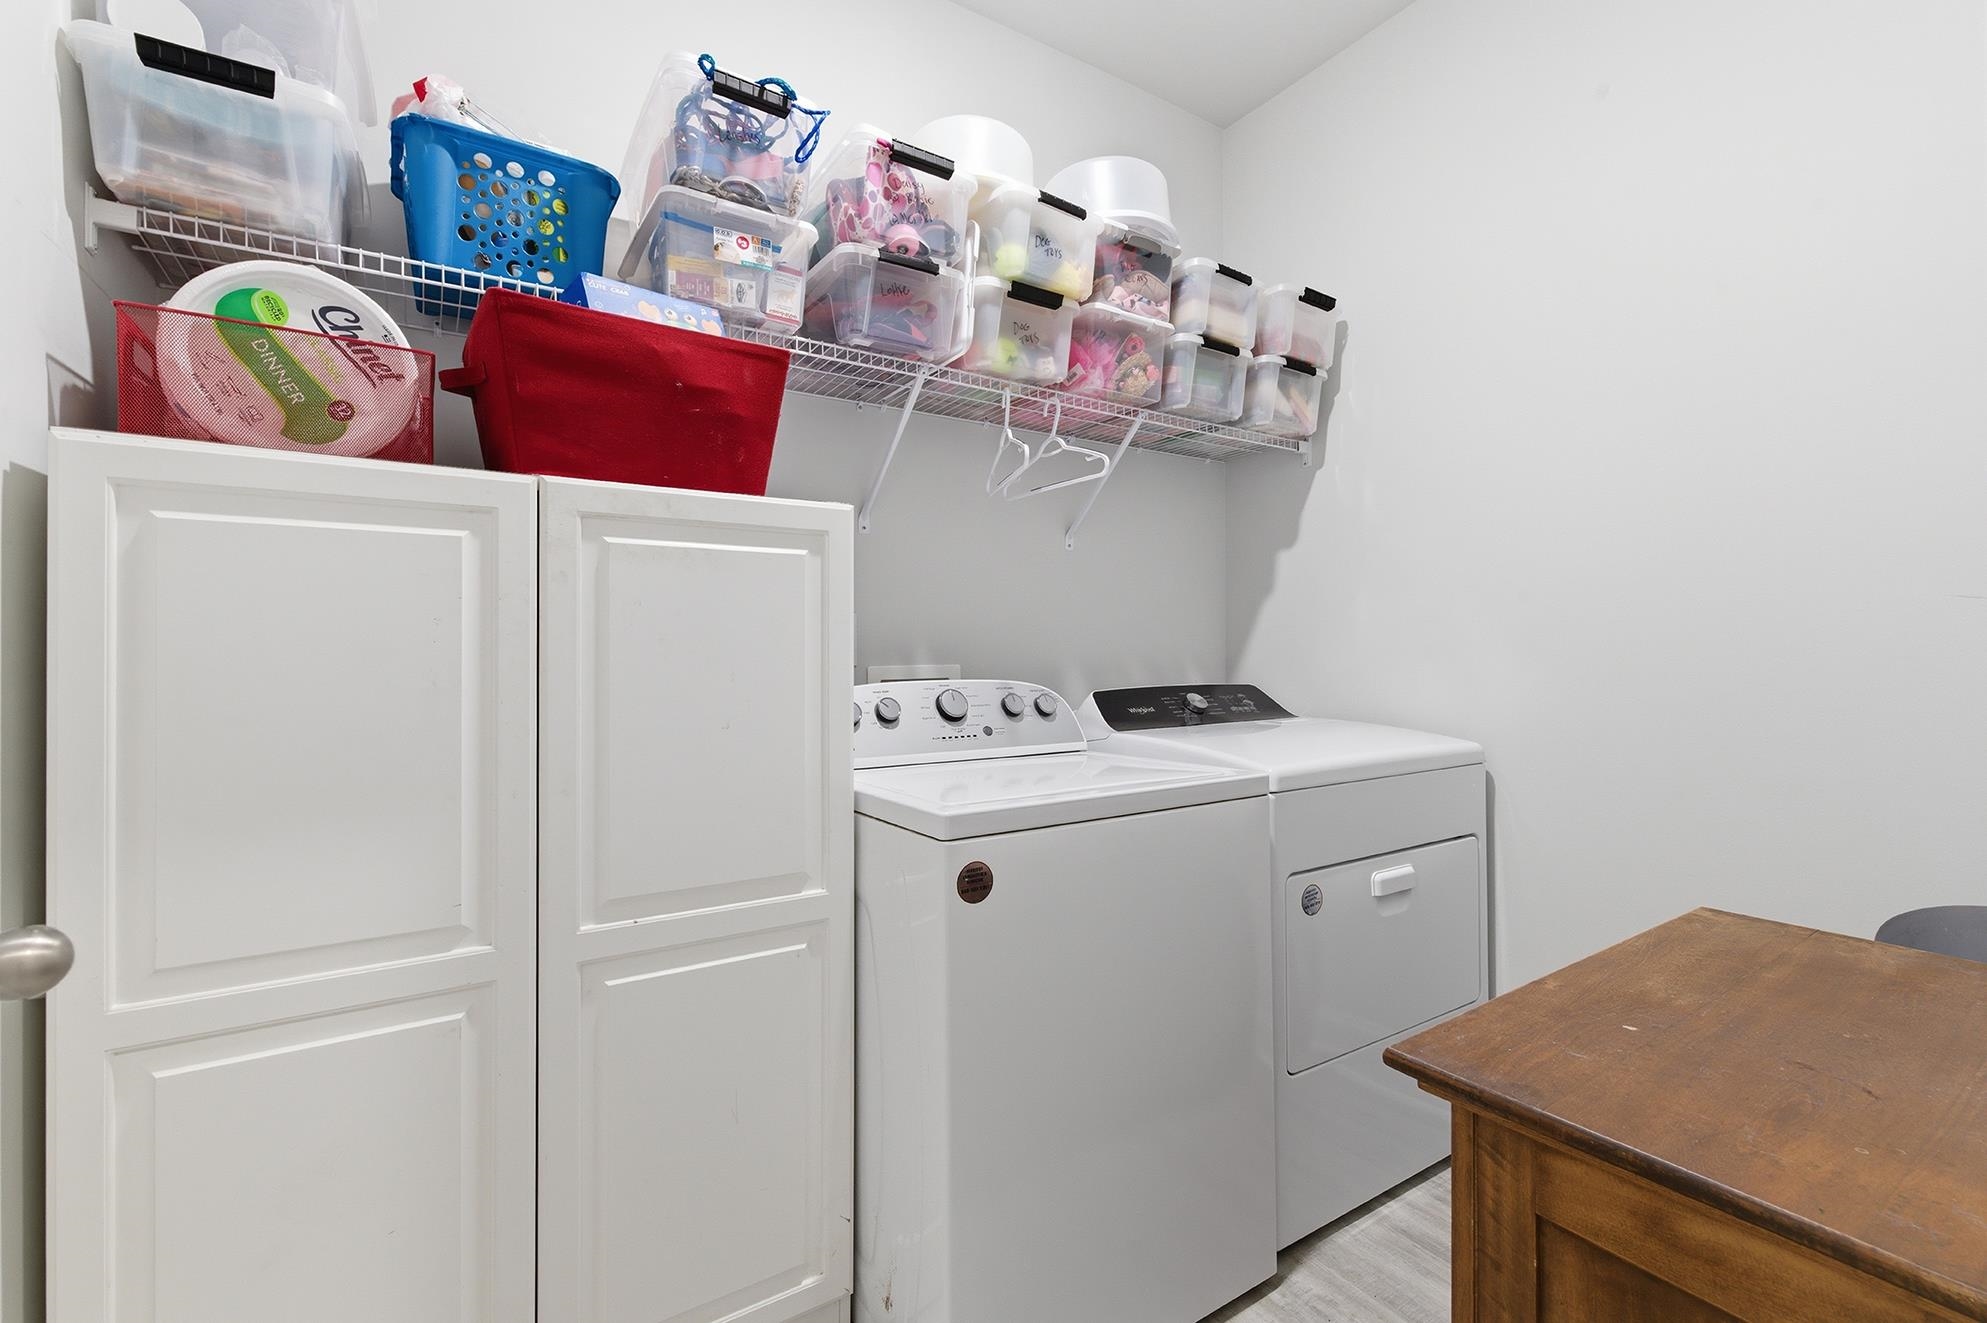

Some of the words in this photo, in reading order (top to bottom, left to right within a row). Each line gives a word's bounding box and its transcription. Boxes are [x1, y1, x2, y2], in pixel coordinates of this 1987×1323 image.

[1034, 234, 1051, 248] DOG
[251, 337, 306, 405] DINNER
[318, 304, 406, 384] Chinet
